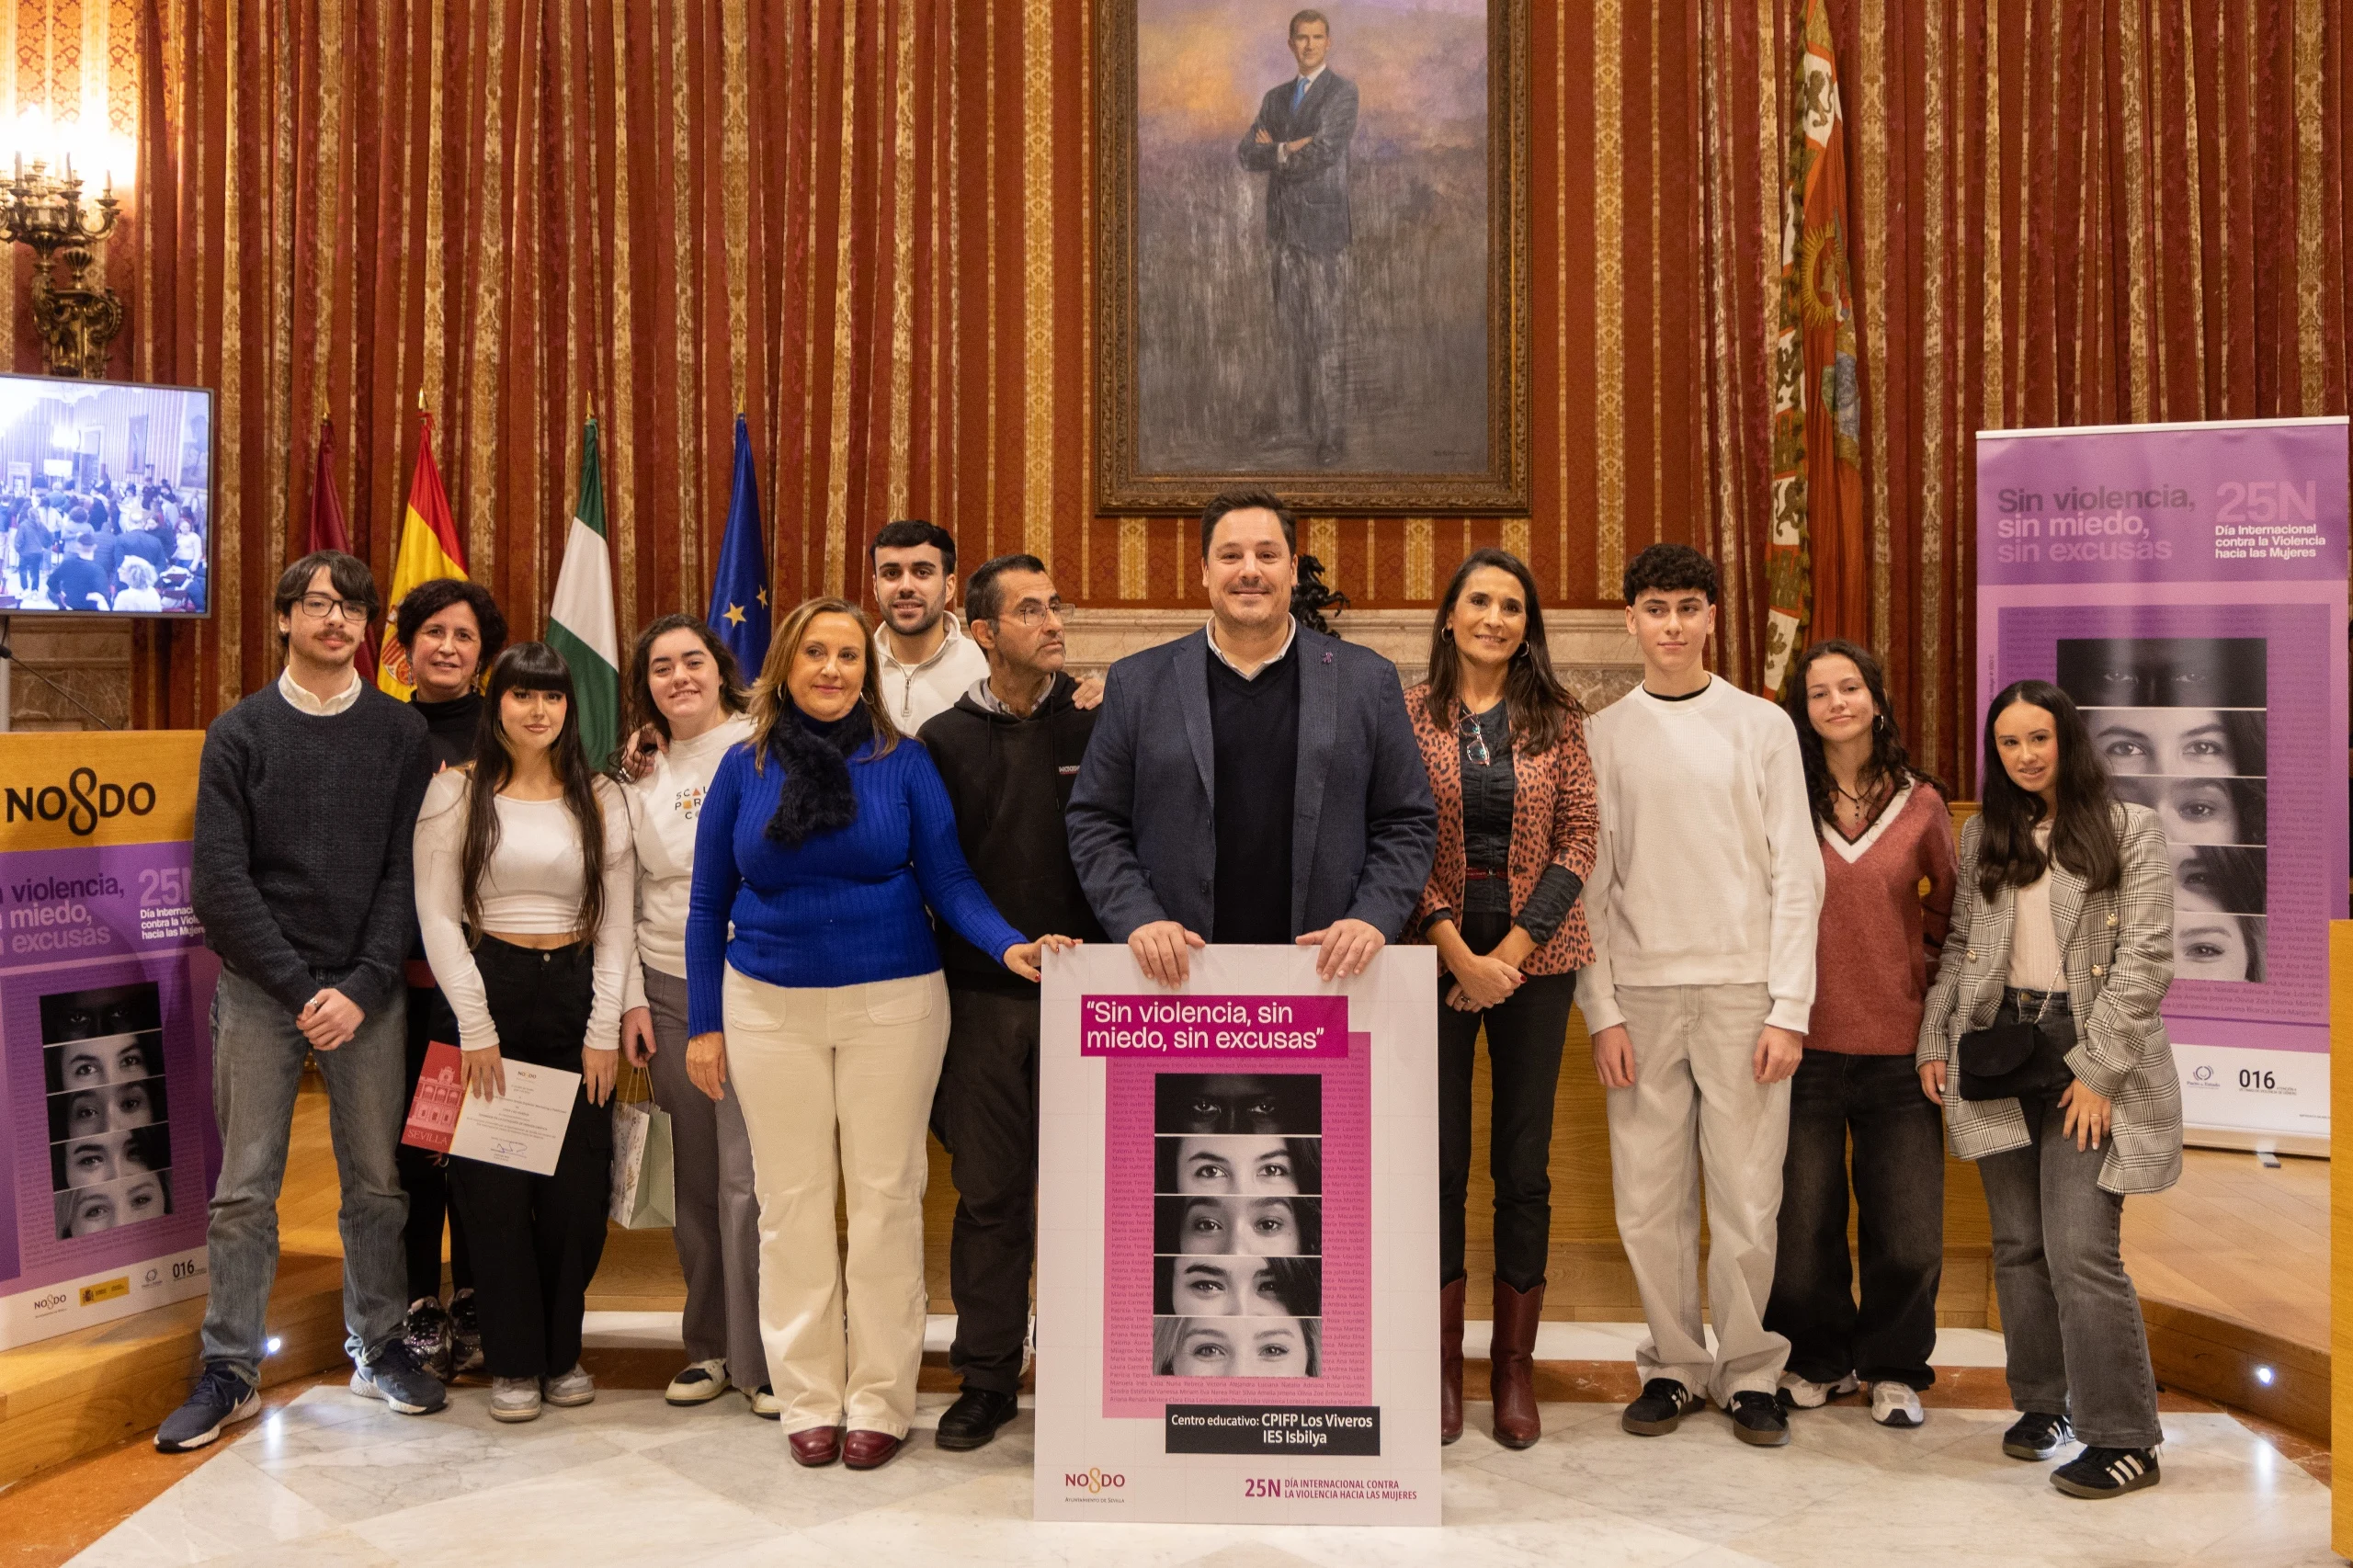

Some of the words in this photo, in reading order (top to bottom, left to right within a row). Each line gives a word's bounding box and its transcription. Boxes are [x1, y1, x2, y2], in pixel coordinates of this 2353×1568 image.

[1998, 488, 2043, 513] Sin
[2054, 484, 2195, 513] violencia,
[2216, 481, 2316, 523] 25N
[1998, 513, 2040, 538] sin
[2049, 510, 2149, 540] miedo,
[2215, 525, 2235, 536] Día
[2238, 524, 2317, 536] Internacional
[1998, 539, 2040, 562] sin
[2049, 540, 2173, 562] excusas
[2215, 537, 2256, 547] contra
[2258, 536, 2268, 546] la
[2271, 535, 2326, 546] Violencia
[2215, 548, 2246, 559] hacia
[2249, 548, 2267, 558] las
[2269, 547, 2316, 561] Mujeres
[11, 874, 125, 903] violencia,
[10, 901, 92, 929] miedo,
[140, 908, 155, 919] Día
[156, 905, 194, 917] Internaci
[141, 919, 170, 930] contra
[171, 917, 179, 926] la
[142, 929, 165, 940] hacia
[165, 928, 178, 937] las
[179, 926, 206, 937] Mujere
[12, 926, 111, 954] excusas
[1087, 1001, 1131, 1023] “Sin
[1138, 1001, 1252, 1027] violencia,
[1257, 1002, 1292, 1023] sin
[1087, 1027, 1166, 1051] miedo,
[1174, 1027, 1209, 1049] sin
[1215, 1027, 1324, 1049] excusas”
[2239, 1069, 2276, 1090] 016
[407, 1129, 449, 1145] SEVILLA
[172, 1259, 195, 1278] 016
[1171, 1414, 1205, 1426] Centro
[1207, 1415, 1259, 1426] educativo:
[1261, 1413, 1298, 1426] CPIFP
[1301, 1414, 1323, 1427] Los
[1324, 1414, 1373, 1427] Viveros
[1263, 1430, 1283, 1444] IES
[1285, 1430, 1327, 1447] Isbilya
[1245, 1478, 1280, 1497] 25N
[1284, 1477, 1299, 1488] DÍA
[1300, 1479, 1364, 1489] INTERNACIONAL
[1367, 1480, 1399, 1489] CONTRA
[1284, 1489, 1294, 1498] LA
[1296, 1490, 1338, 1499] VIOLENCIA
[1340, 1490, 1364, 1499] HACIA
[1366, 1490, 1381, 1500] LAS
[1381, 1491, 1417, 1502] MUJERES
